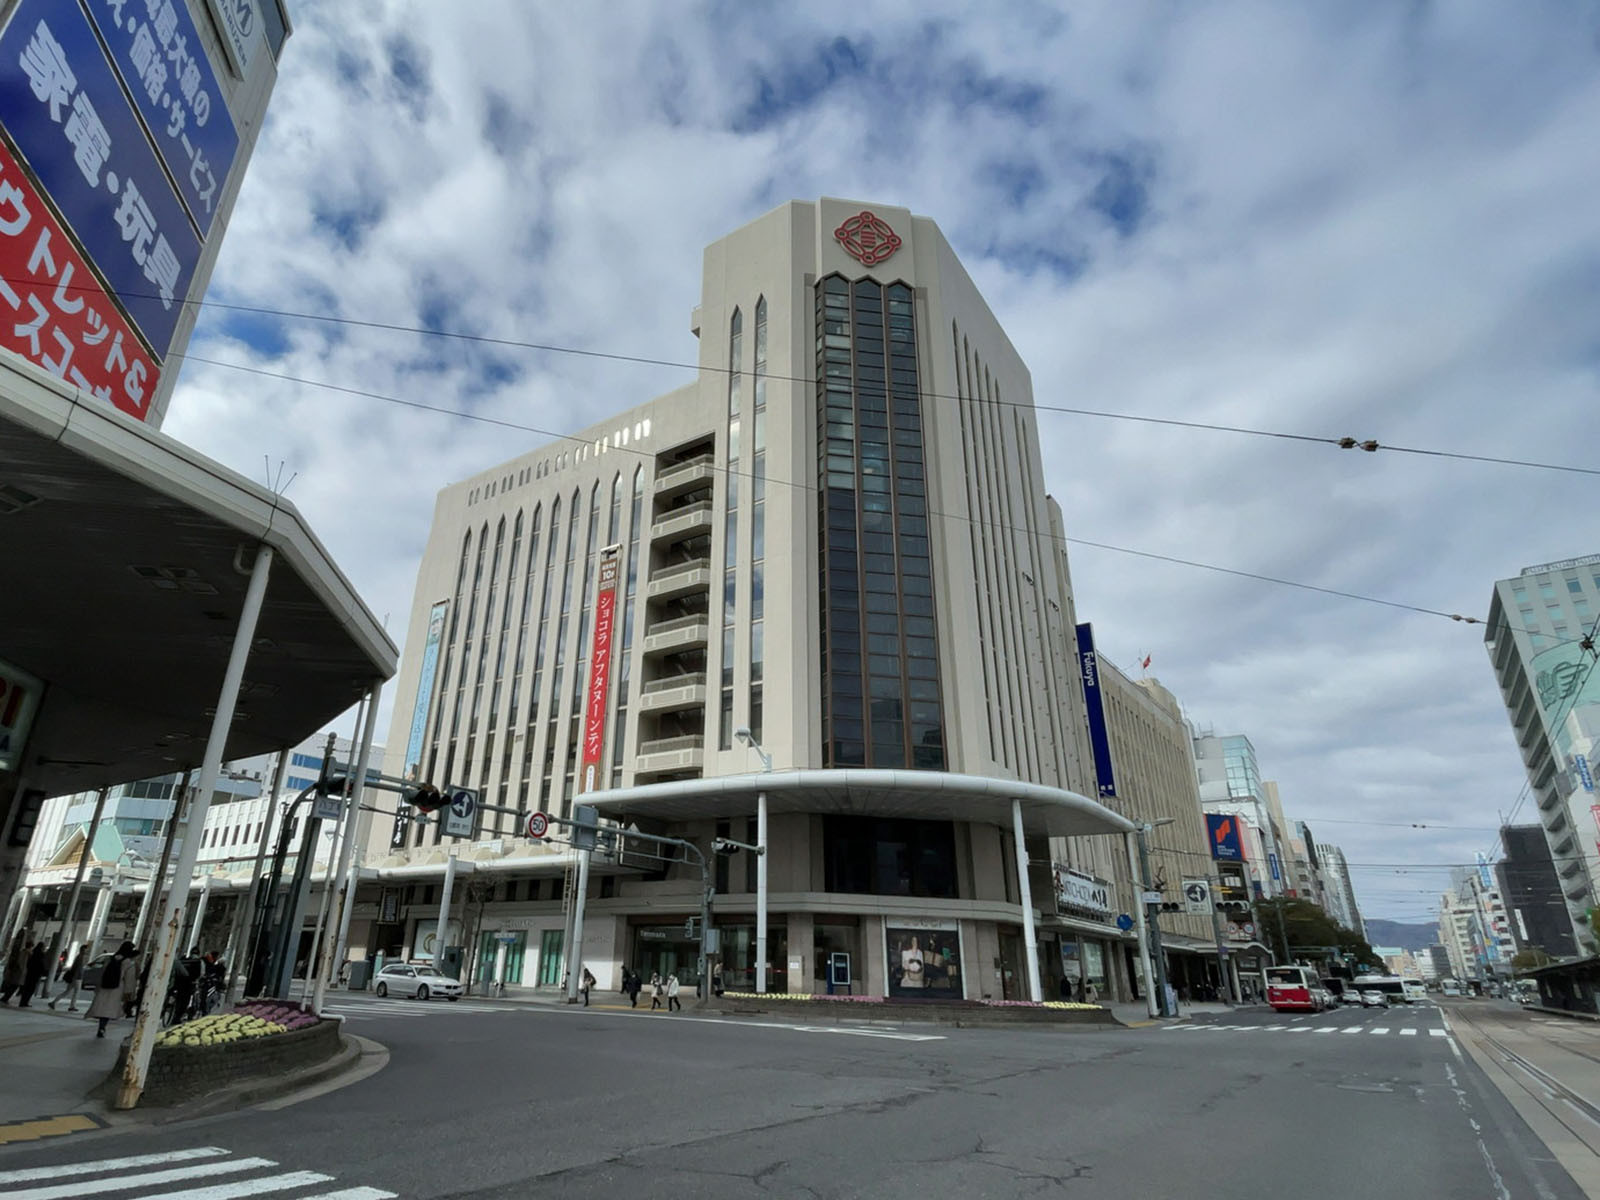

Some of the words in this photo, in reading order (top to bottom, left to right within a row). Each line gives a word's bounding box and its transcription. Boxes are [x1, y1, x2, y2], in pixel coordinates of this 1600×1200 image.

[19, 19, 181, 310] 家電・玩具
[0, 160, 147, 407] ウトレット&
[598, 597, 611, 645] ショコラ
[1083, 651, 1095, 687] Fukuya
[532, 817, 545, 832] 50
